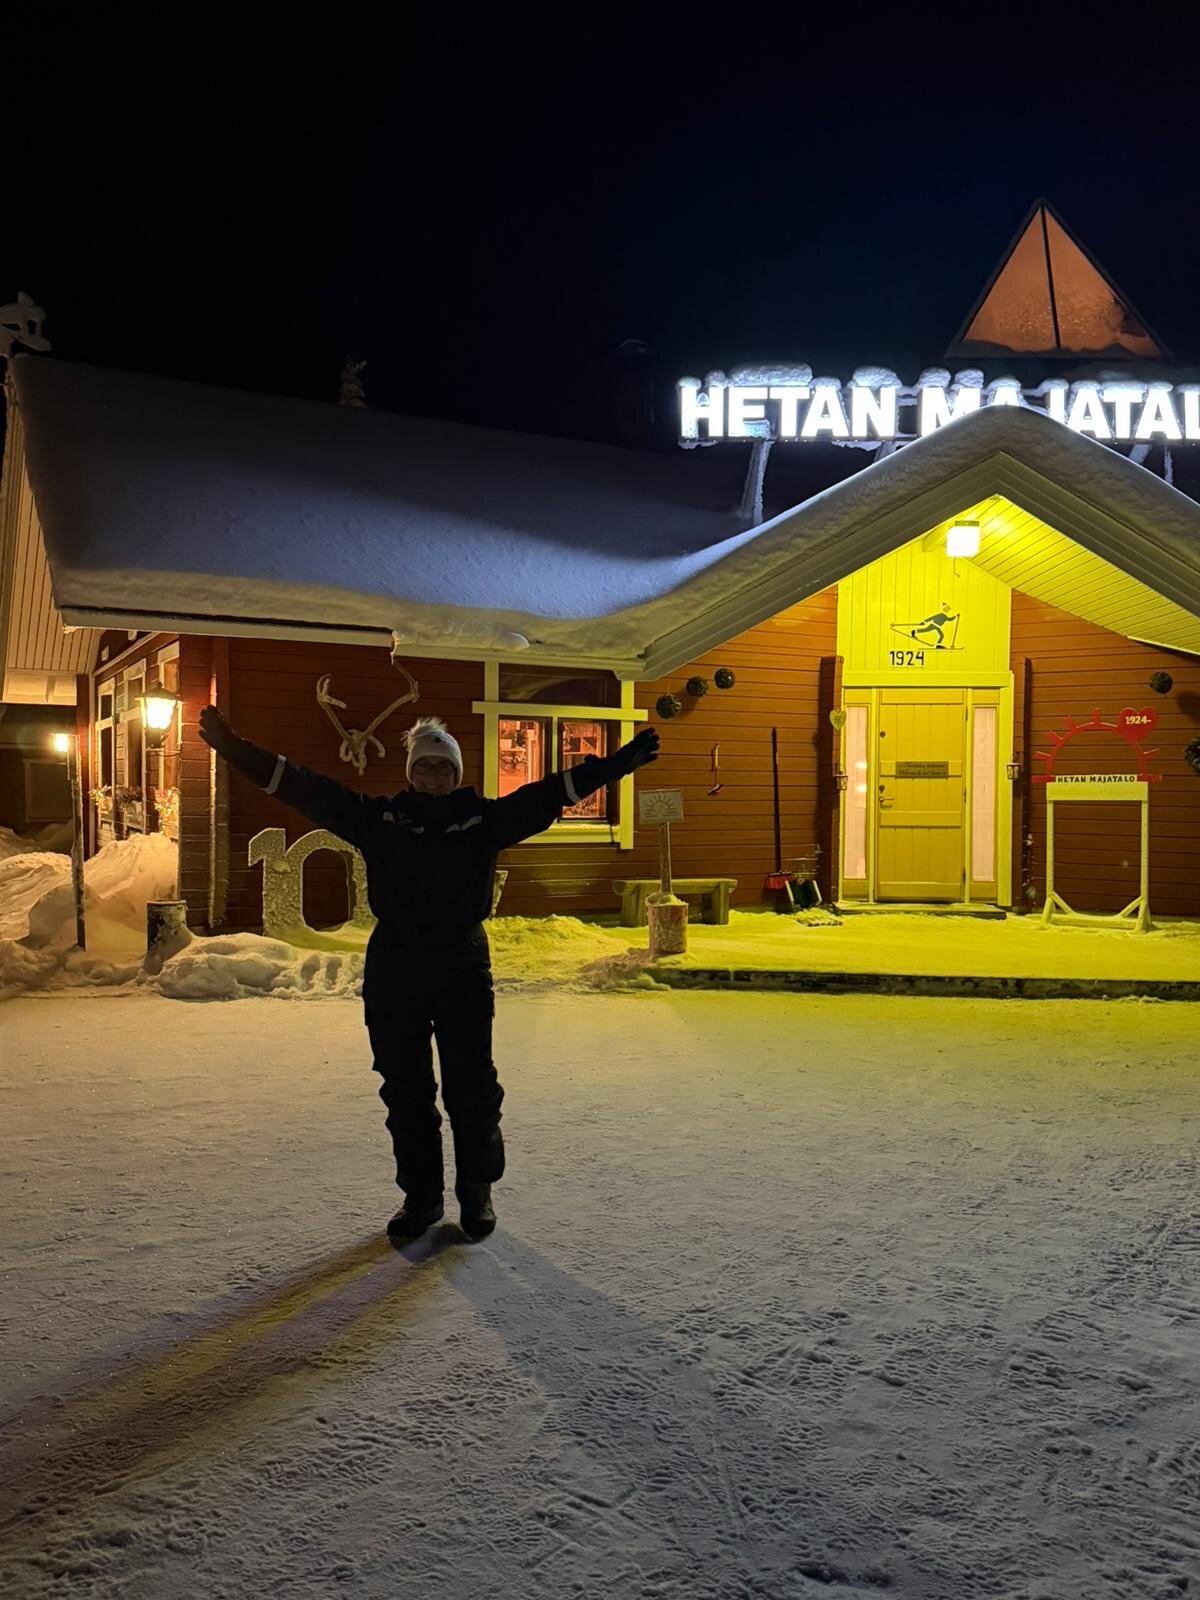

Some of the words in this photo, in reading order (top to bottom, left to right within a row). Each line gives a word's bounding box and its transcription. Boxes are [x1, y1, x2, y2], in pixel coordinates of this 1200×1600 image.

[679, 386, 899, 439] HETAN
[890, 651, 924, 667] 1924
[1057, 775, 1086, 783] HETAN
[1089, 775, 1136, 784] MAJATALO
